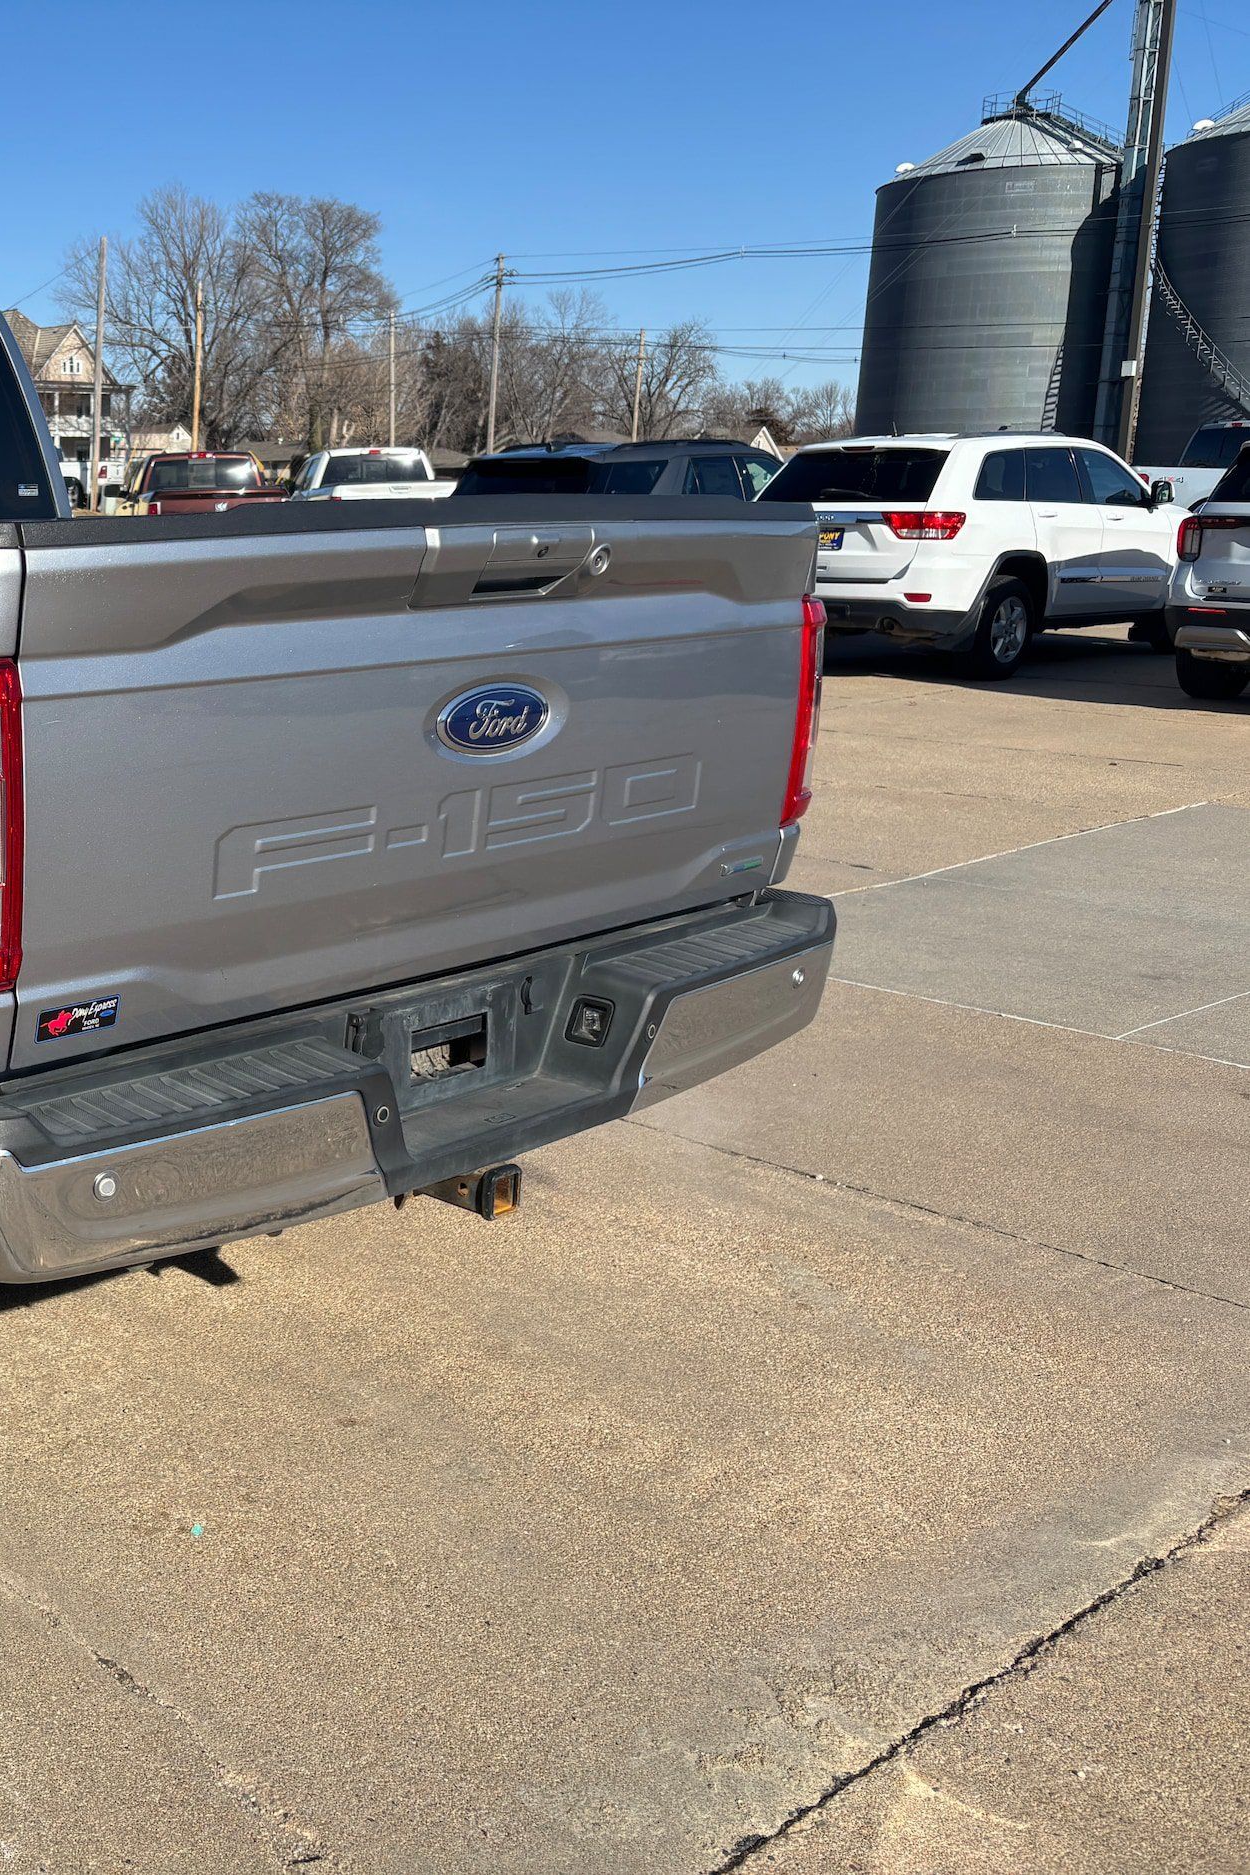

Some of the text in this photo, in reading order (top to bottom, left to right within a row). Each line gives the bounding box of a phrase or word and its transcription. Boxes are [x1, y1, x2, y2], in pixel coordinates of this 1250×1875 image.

[468, 698, 530, 740] Ford
[212, 751, 703, 901] F-150
[88, 998, 118, 1018] Express
